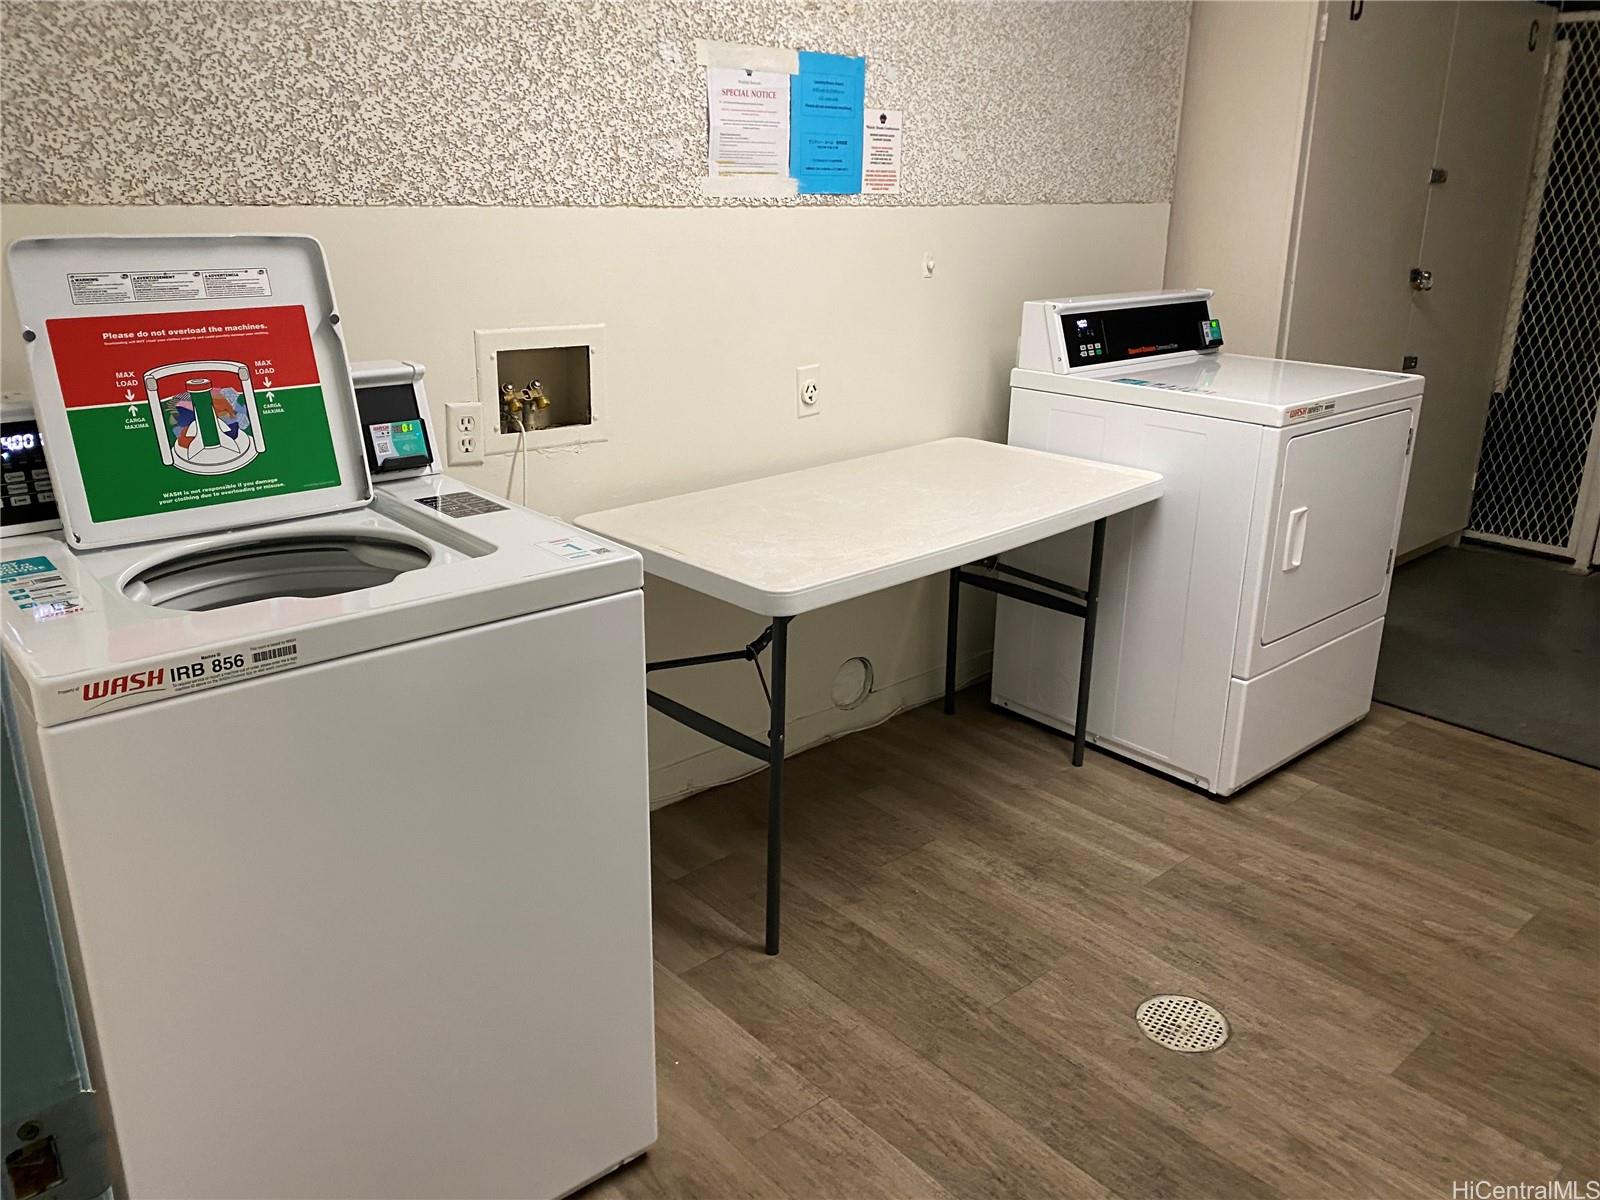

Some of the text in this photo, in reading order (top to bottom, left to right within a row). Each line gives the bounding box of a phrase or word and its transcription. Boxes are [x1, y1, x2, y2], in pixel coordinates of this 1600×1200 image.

[721, 88, 777, 99] SPECIAL NOTICE
[168, 326, 206, 335] overload
[224, 324, 268, 332] machines.
[202, 484, 236, 492] responsible
[221, 487, 255, 496] overloading
[170, 662, 205, 682] IRB
[212, 654, 244, 672] 856
[83, 668, 164, 701] WASH
